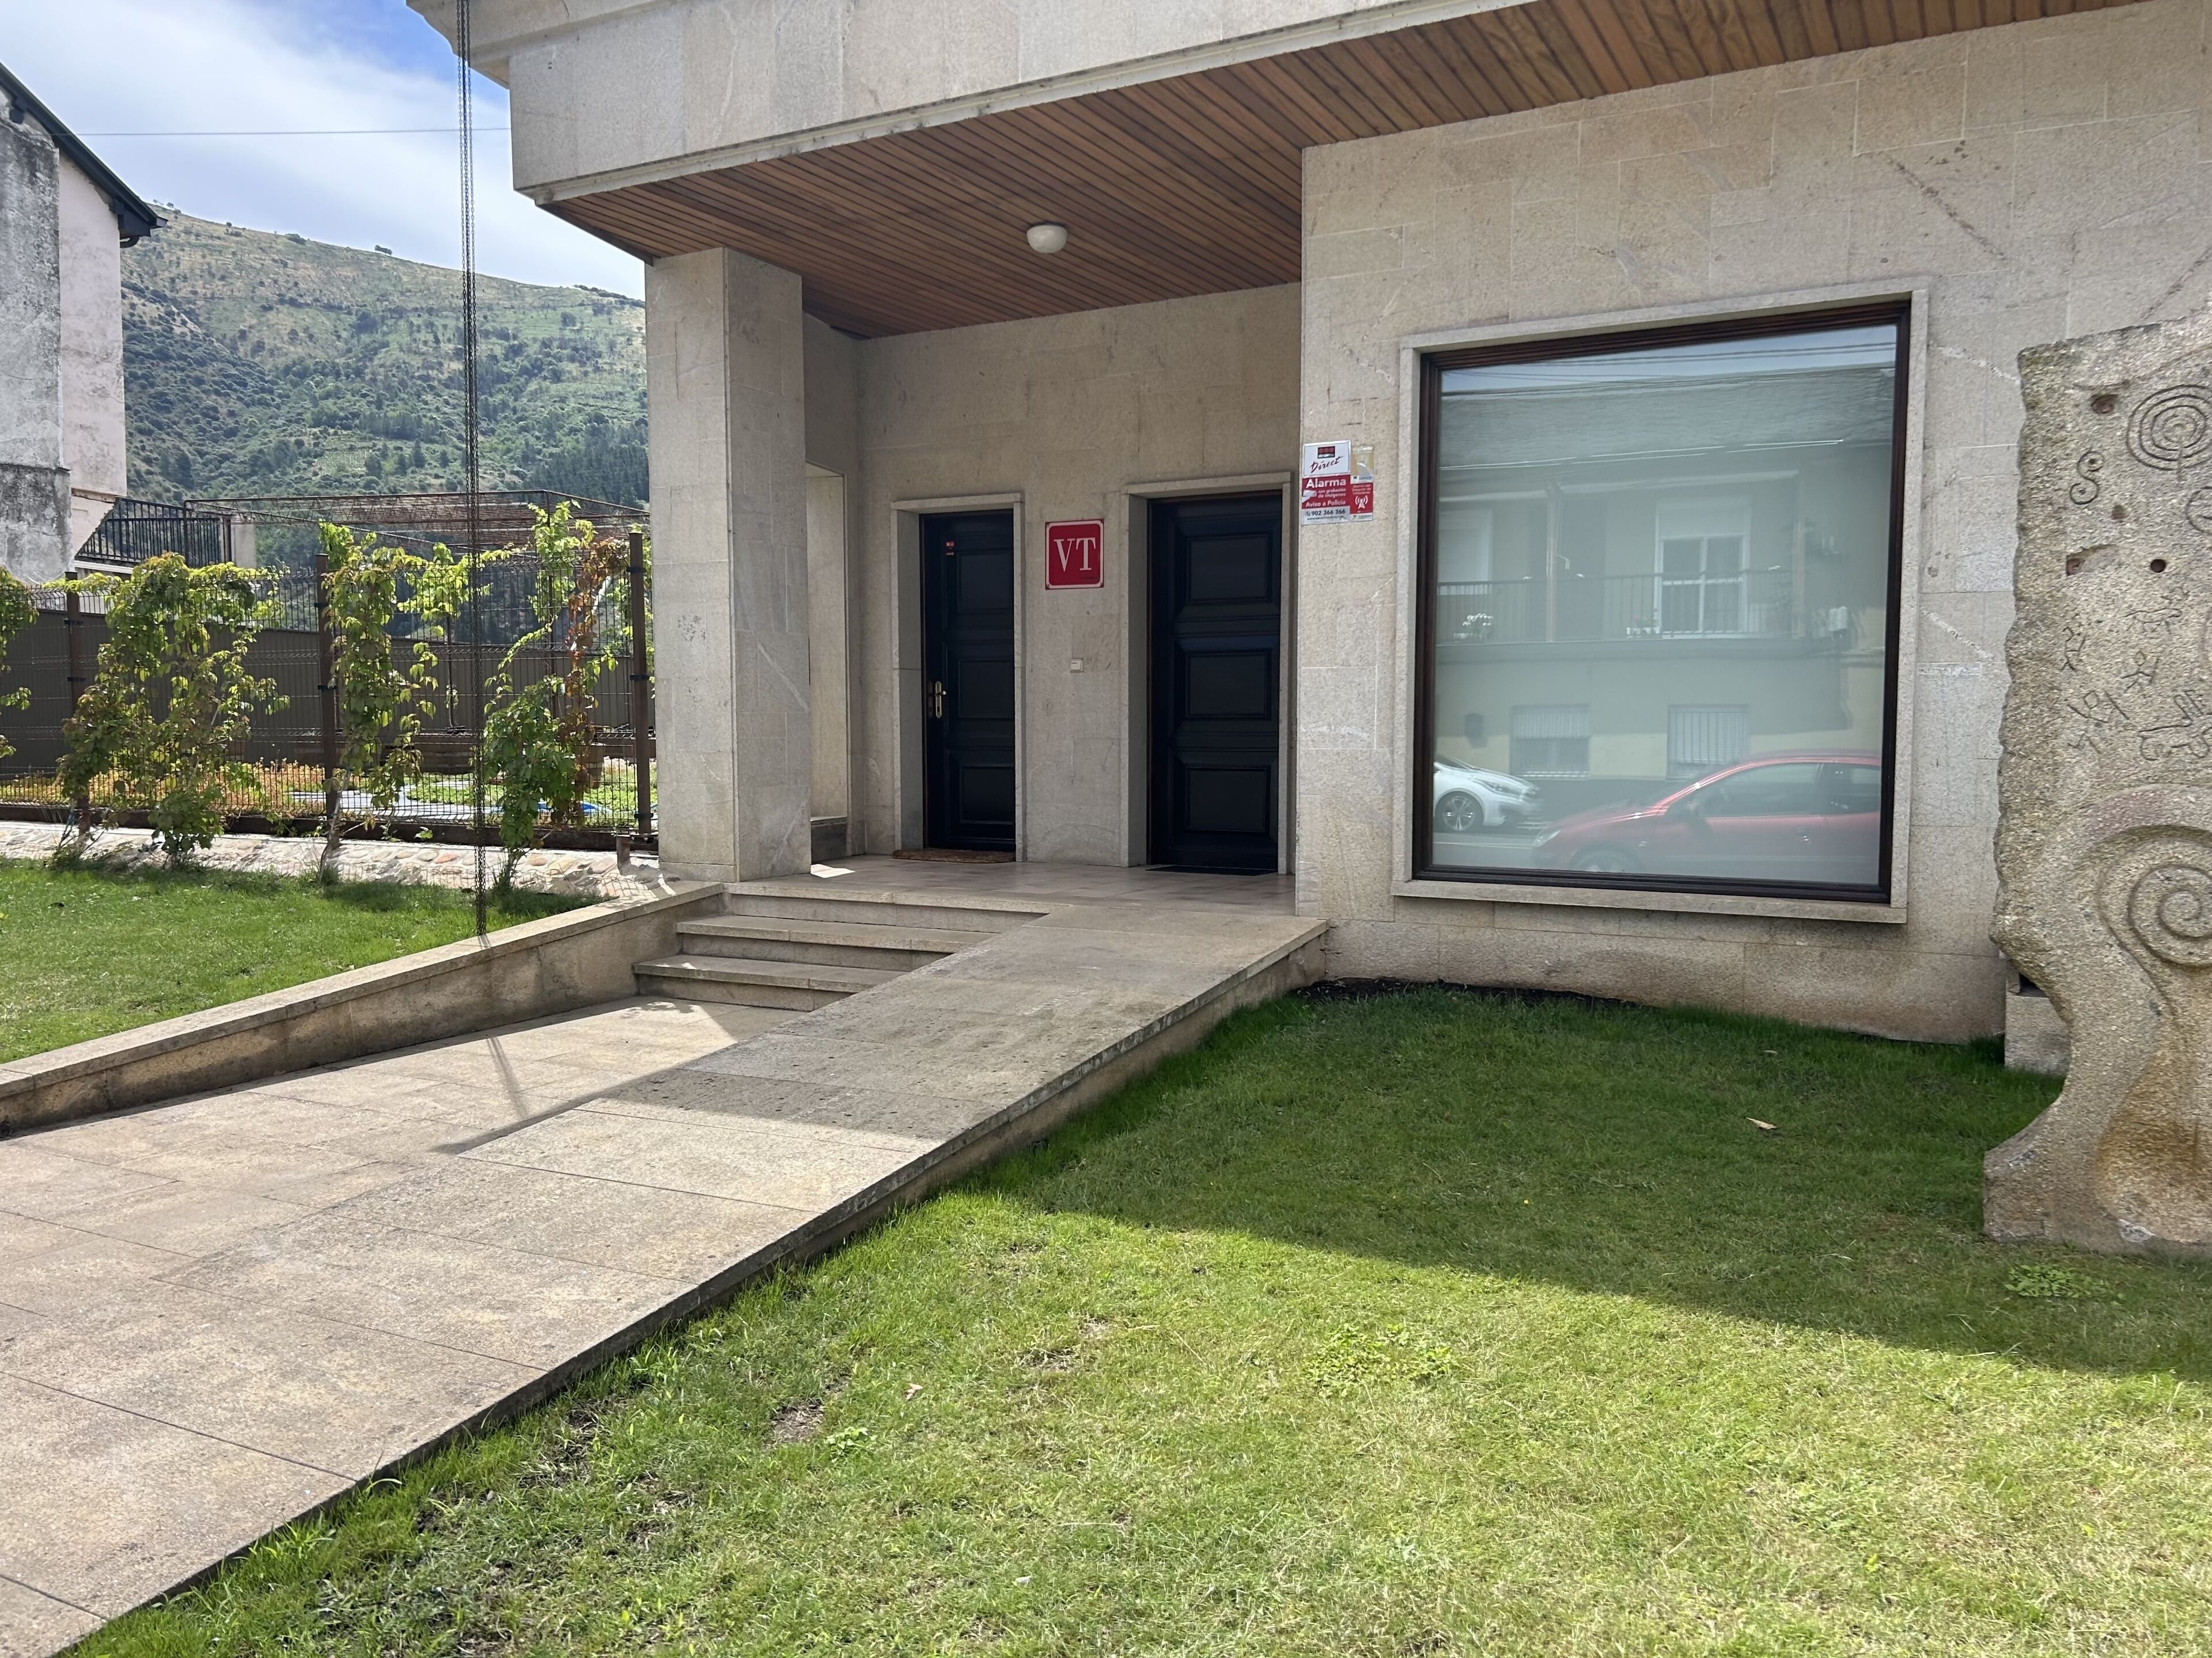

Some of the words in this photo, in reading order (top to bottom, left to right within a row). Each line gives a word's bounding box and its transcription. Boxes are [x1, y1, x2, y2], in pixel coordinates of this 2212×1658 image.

[1310, 456, 1344, 473] Direct
[1306, 479, 1346, 488] Alarma
[1053, 537, 1096, 572] VT
